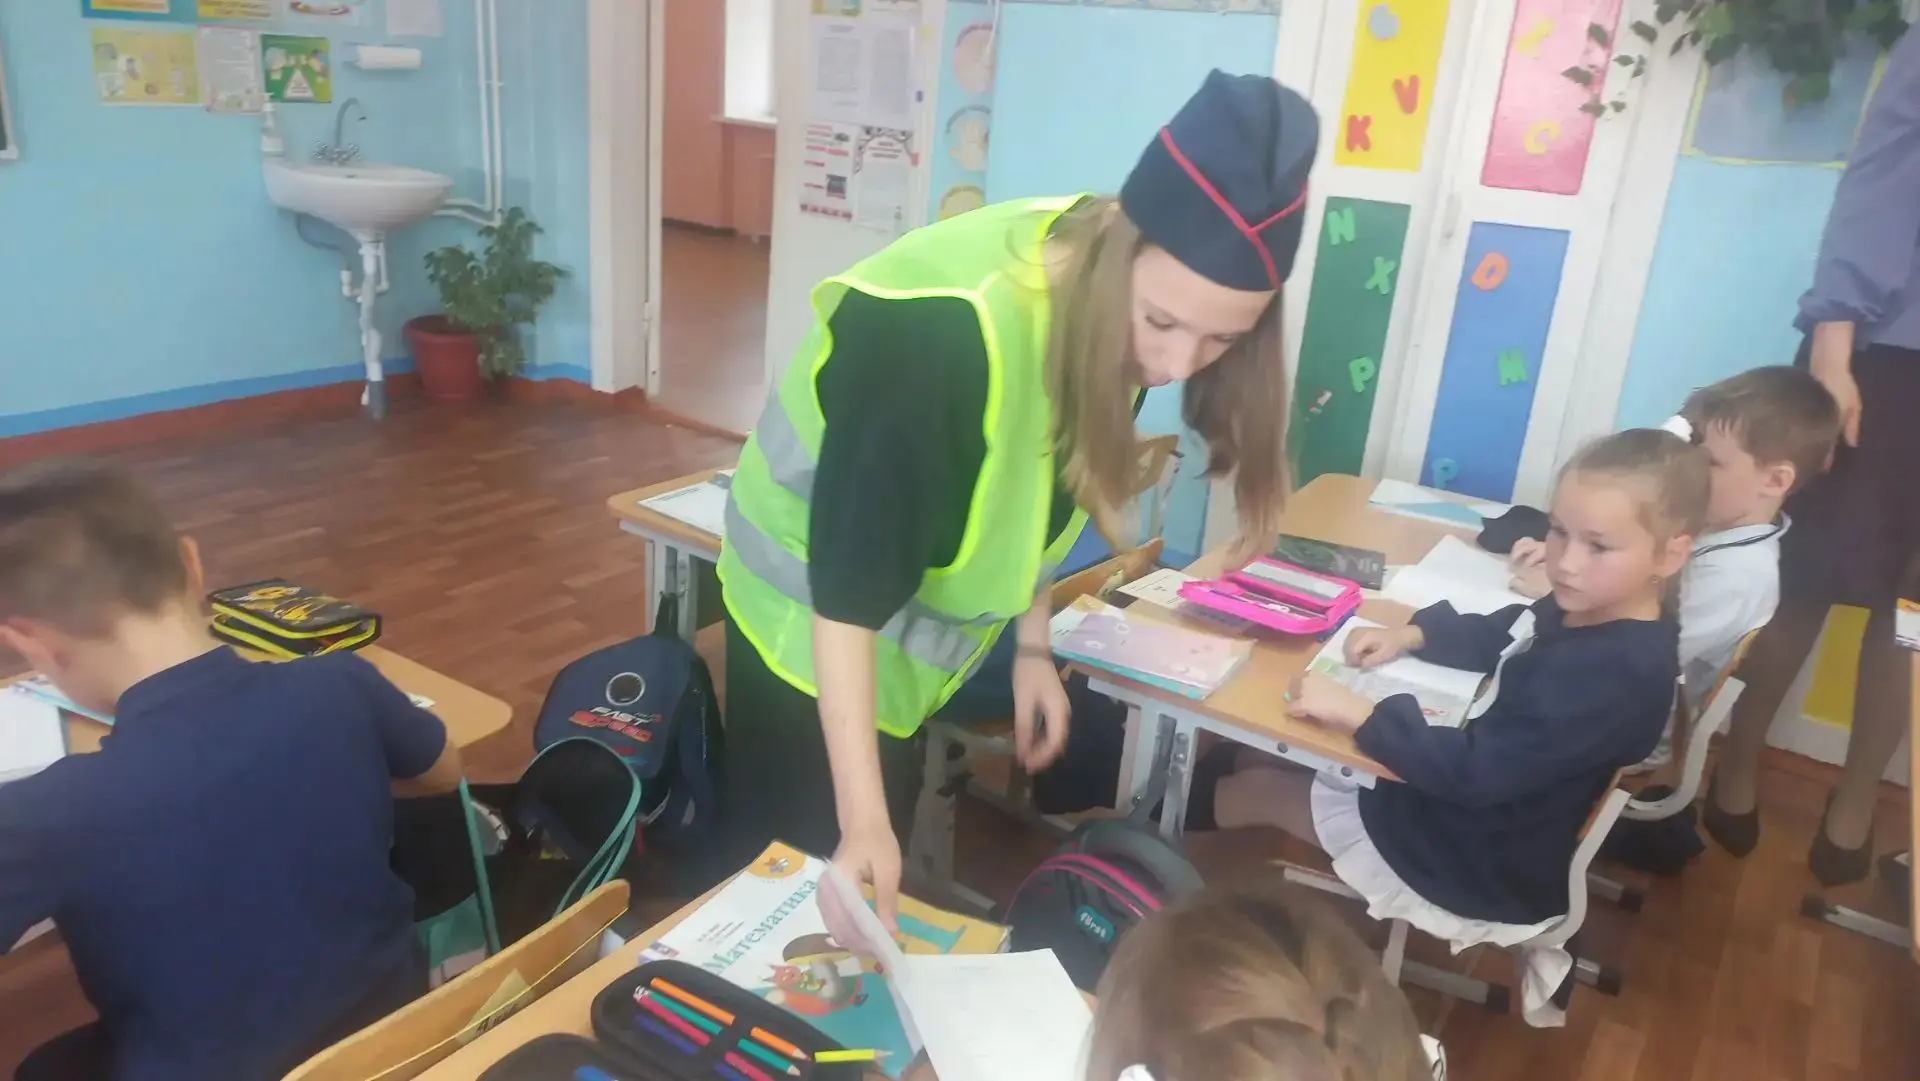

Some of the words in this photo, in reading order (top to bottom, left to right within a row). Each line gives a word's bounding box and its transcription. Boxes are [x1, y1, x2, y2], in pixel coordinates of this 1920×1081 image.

[1392, 74, 1420, 114] V
[1345, 114, 1372, 152] K
[1327, 206, 1356, 245] N
[1365, 256, 1396, 294] X
[1471, 252, 1509, 292] D
[1349, 356, 1375, 393] P
[1431, 457, 1459, 490] P
[589, 706, 653, 726] FAST
[702, 879, 818, 975] Математика
